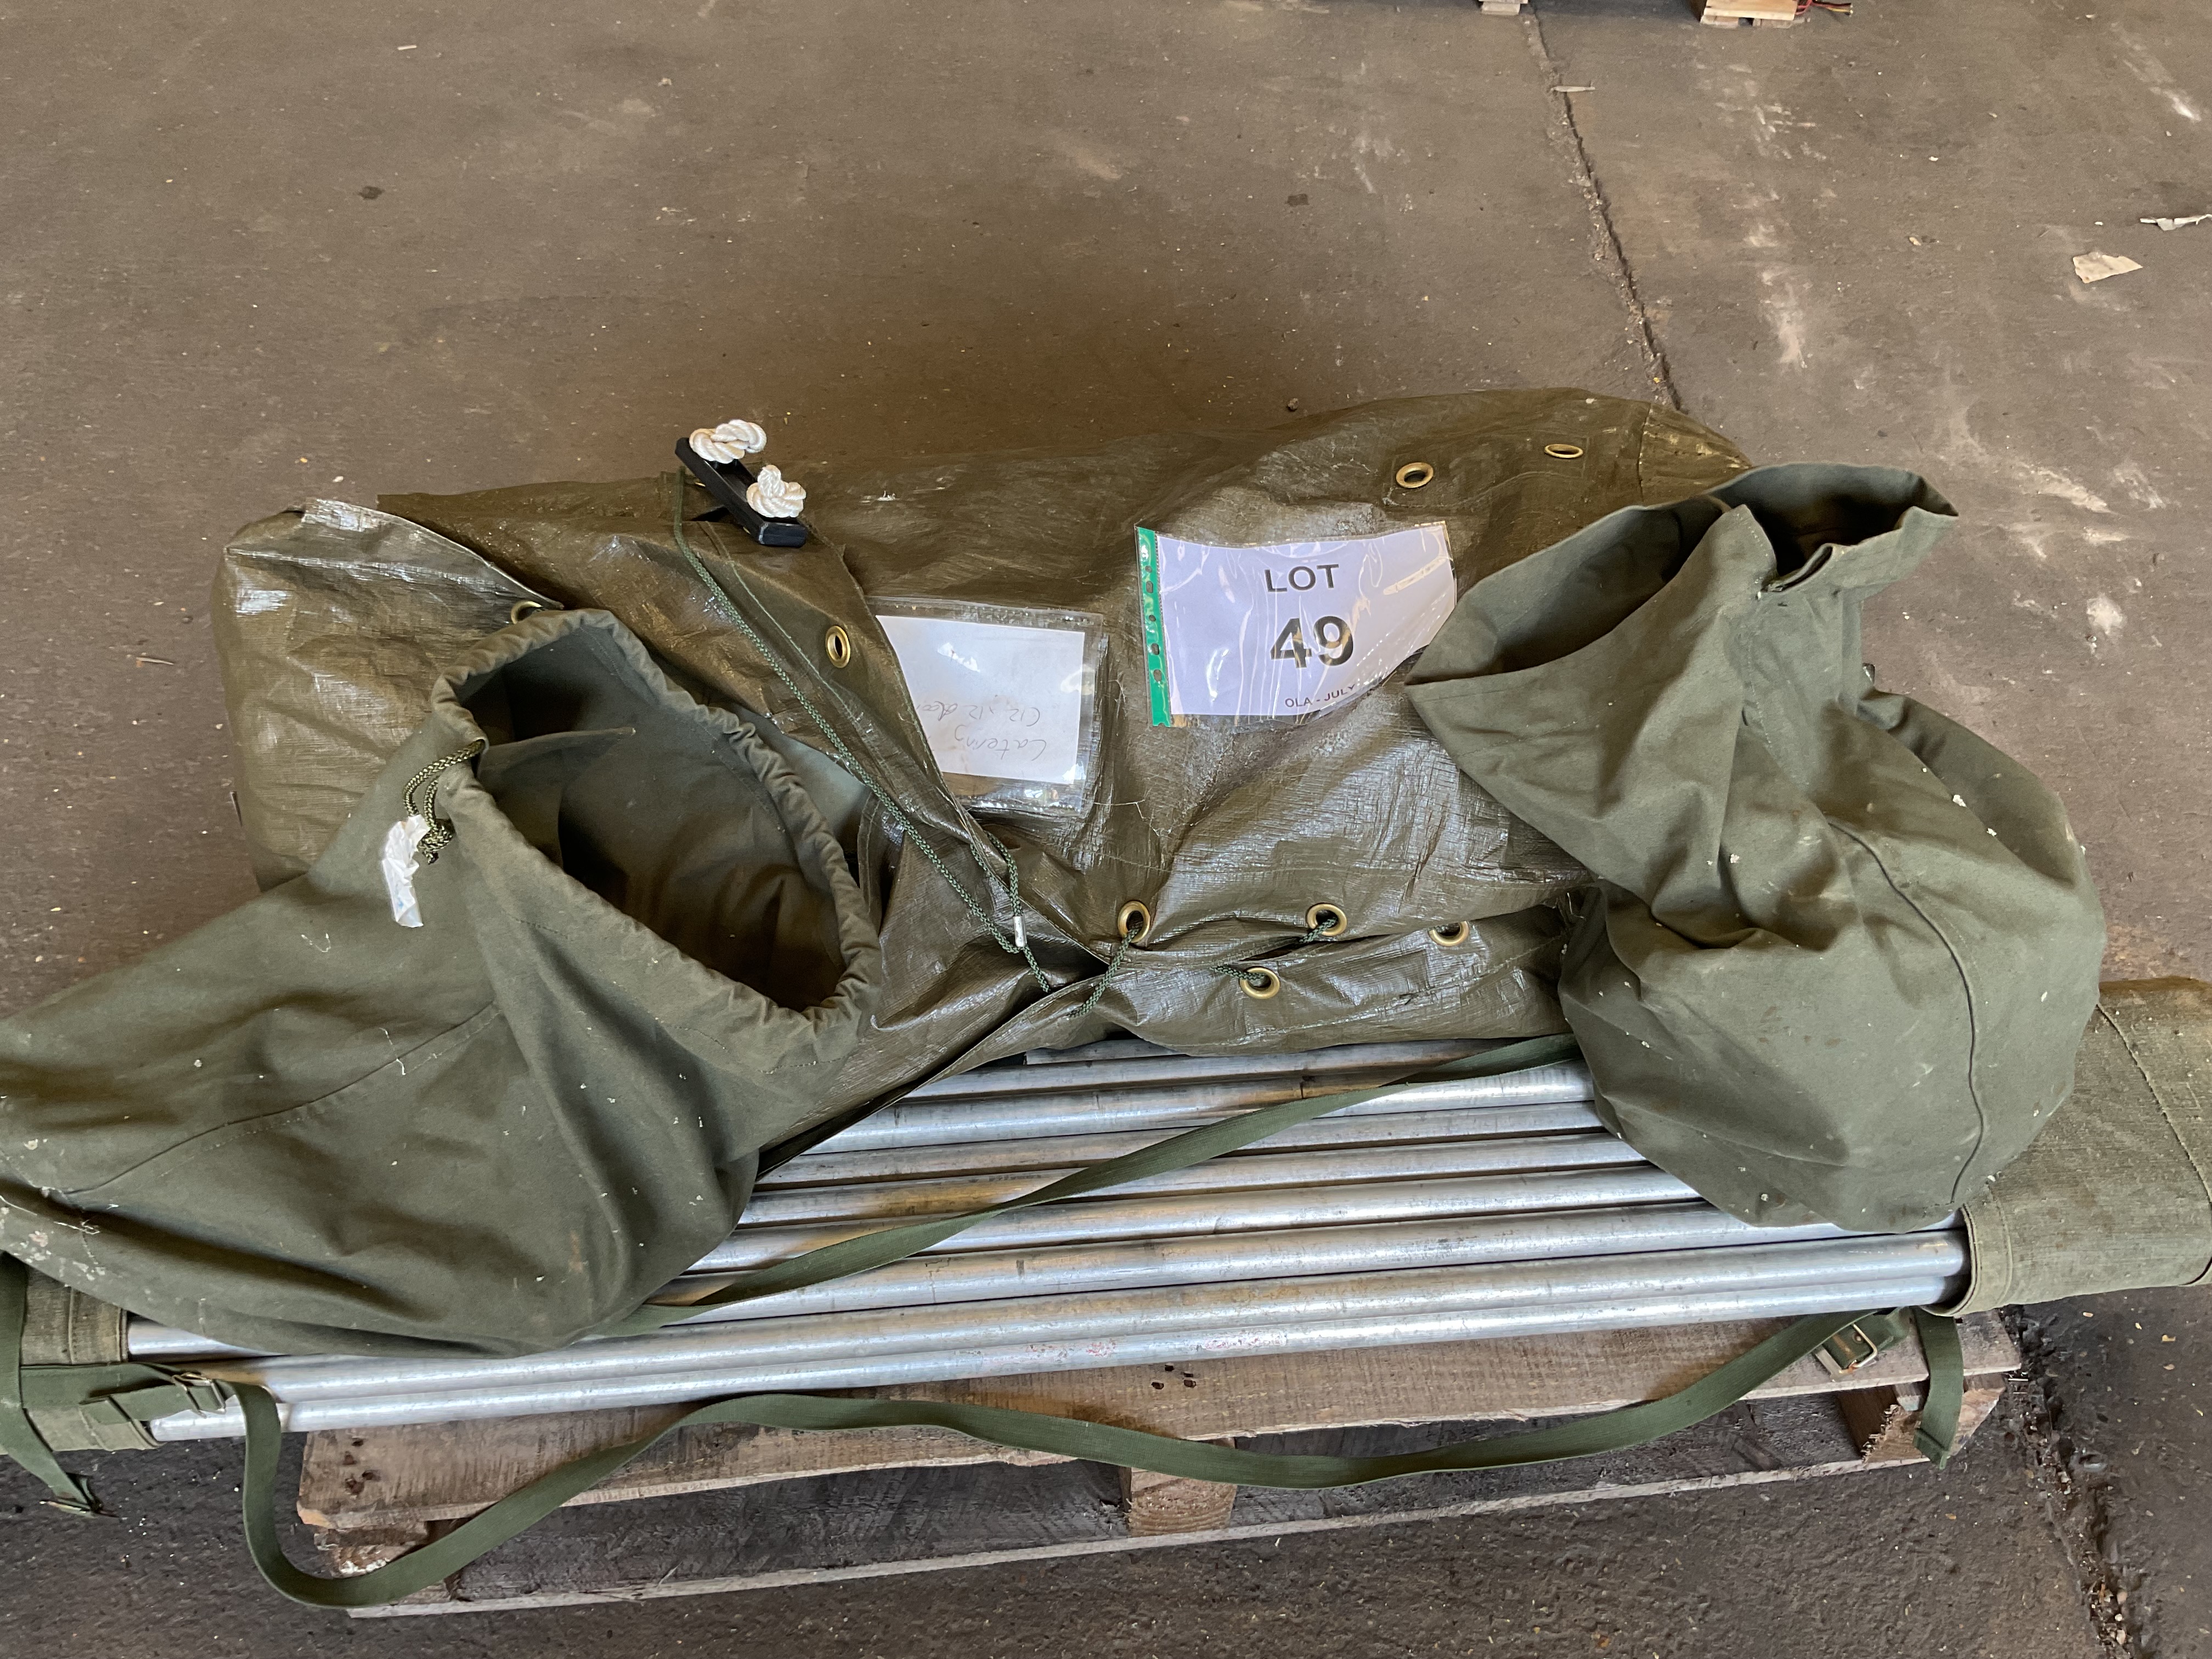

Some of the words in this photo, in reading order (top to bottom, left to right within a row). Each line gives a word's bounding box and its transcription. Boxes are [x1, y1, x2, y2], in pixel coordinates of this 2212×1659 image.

[1264, 564, 1340, 593] LOT
[1269, 615, 1355, 669] 49
[1285, 697, 1313, 708] OLA
[1324, 684, 1356, 702] JULY
[955, 725, 1047, 761] Catering
